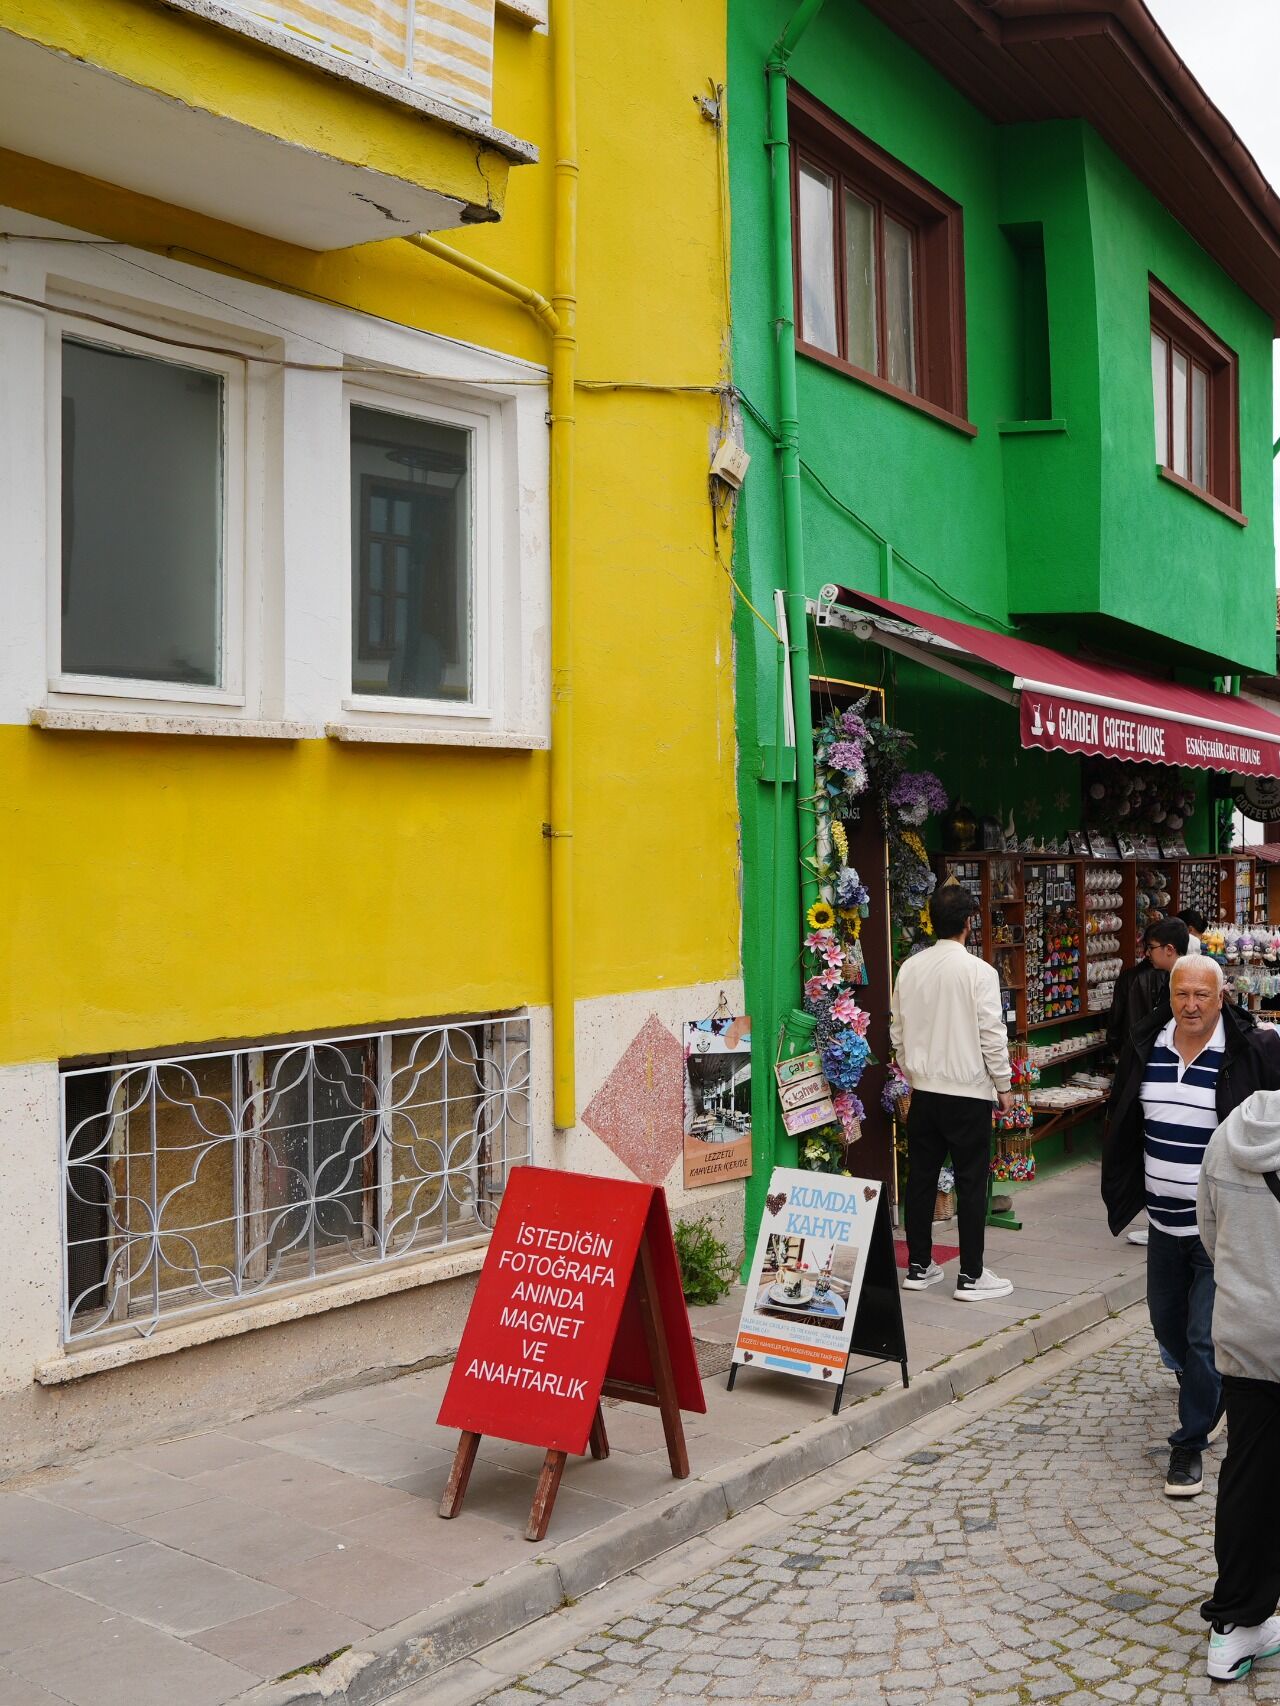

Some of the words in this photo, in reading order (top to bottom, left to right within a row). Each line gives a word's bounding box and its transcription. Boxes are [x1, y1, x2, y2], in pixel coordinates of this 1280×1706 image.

[1059, 706, 1099, 745] GARDEN
[1103, 716, 1135, 752] COFFEE
[1136, 724, 1166, 757] HOUSE
[1185, 735, 1224, 761] ESKİŞEHİR
[1223, 743, 1239, 762] GIFT
[1239, 747, 1261, 766] HOUSE
[1235, 793, 1268, 820] COFFEE
[788, 1061, 805, 1077] çay
[792, 1081, 820, 1104] kahve
[689, 1162, 722, 1177] KAHVELER
[788, 1185, 858, 1216] KUMDA
[515, 1221, 614, 1259] İSTEDİĞİN
[785, 1212, 852, 1242] KAHVE
[498, 1250, 616, 1288] FOTOĞRAFA
[511, 1280, 586, 1313] ANINDA
[499, 1306, 585, 1341] MAGNET
[522, 1339, 546, 1364] VE
[464, 1358, 590, 1401] ANAHTARLIK
